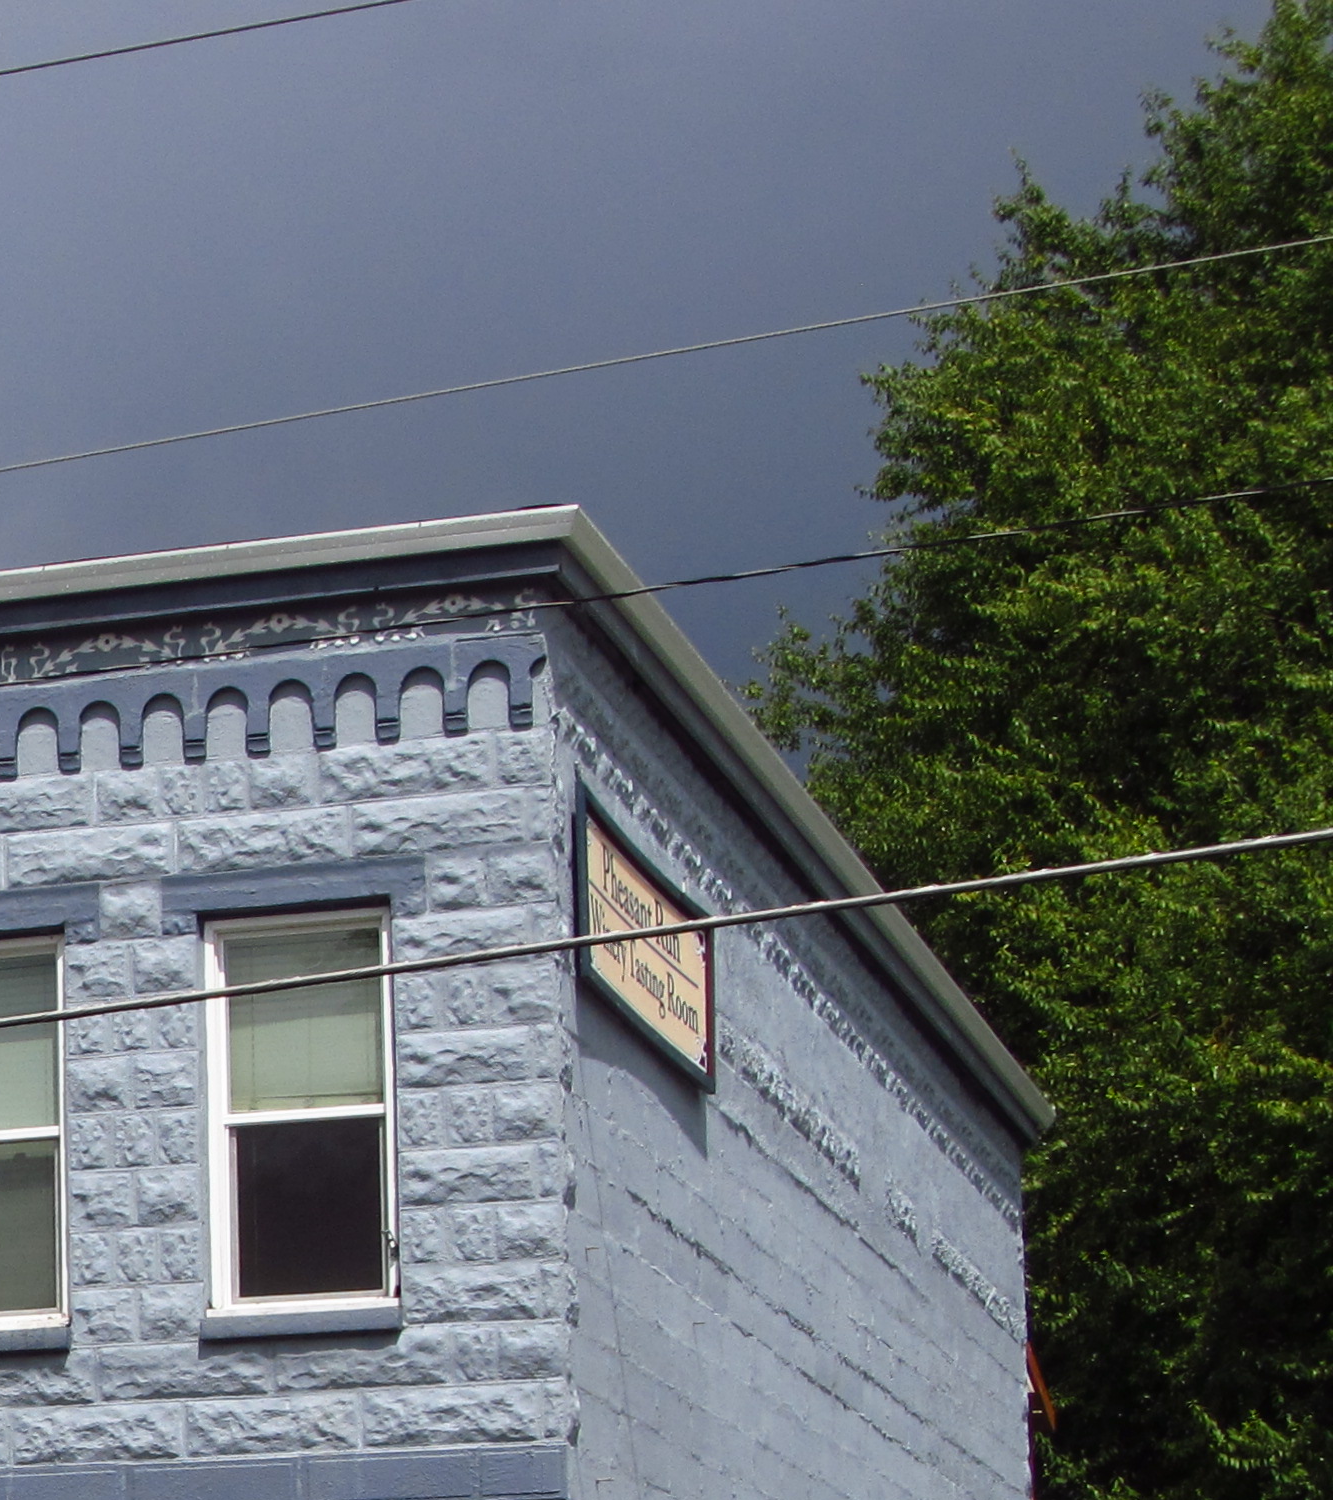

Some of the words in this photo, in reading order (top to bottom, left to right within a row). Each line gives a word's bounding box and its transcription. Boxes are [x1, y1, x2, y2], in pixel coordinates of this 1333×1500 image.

[590, 893, 628, 982] Winery
[630, 938, 666, 1020] Tasting
[666, 972, 699, 1035] Room
[601, 843, 653, 928] Pheasant
[655, 897, 681, 964] Run
